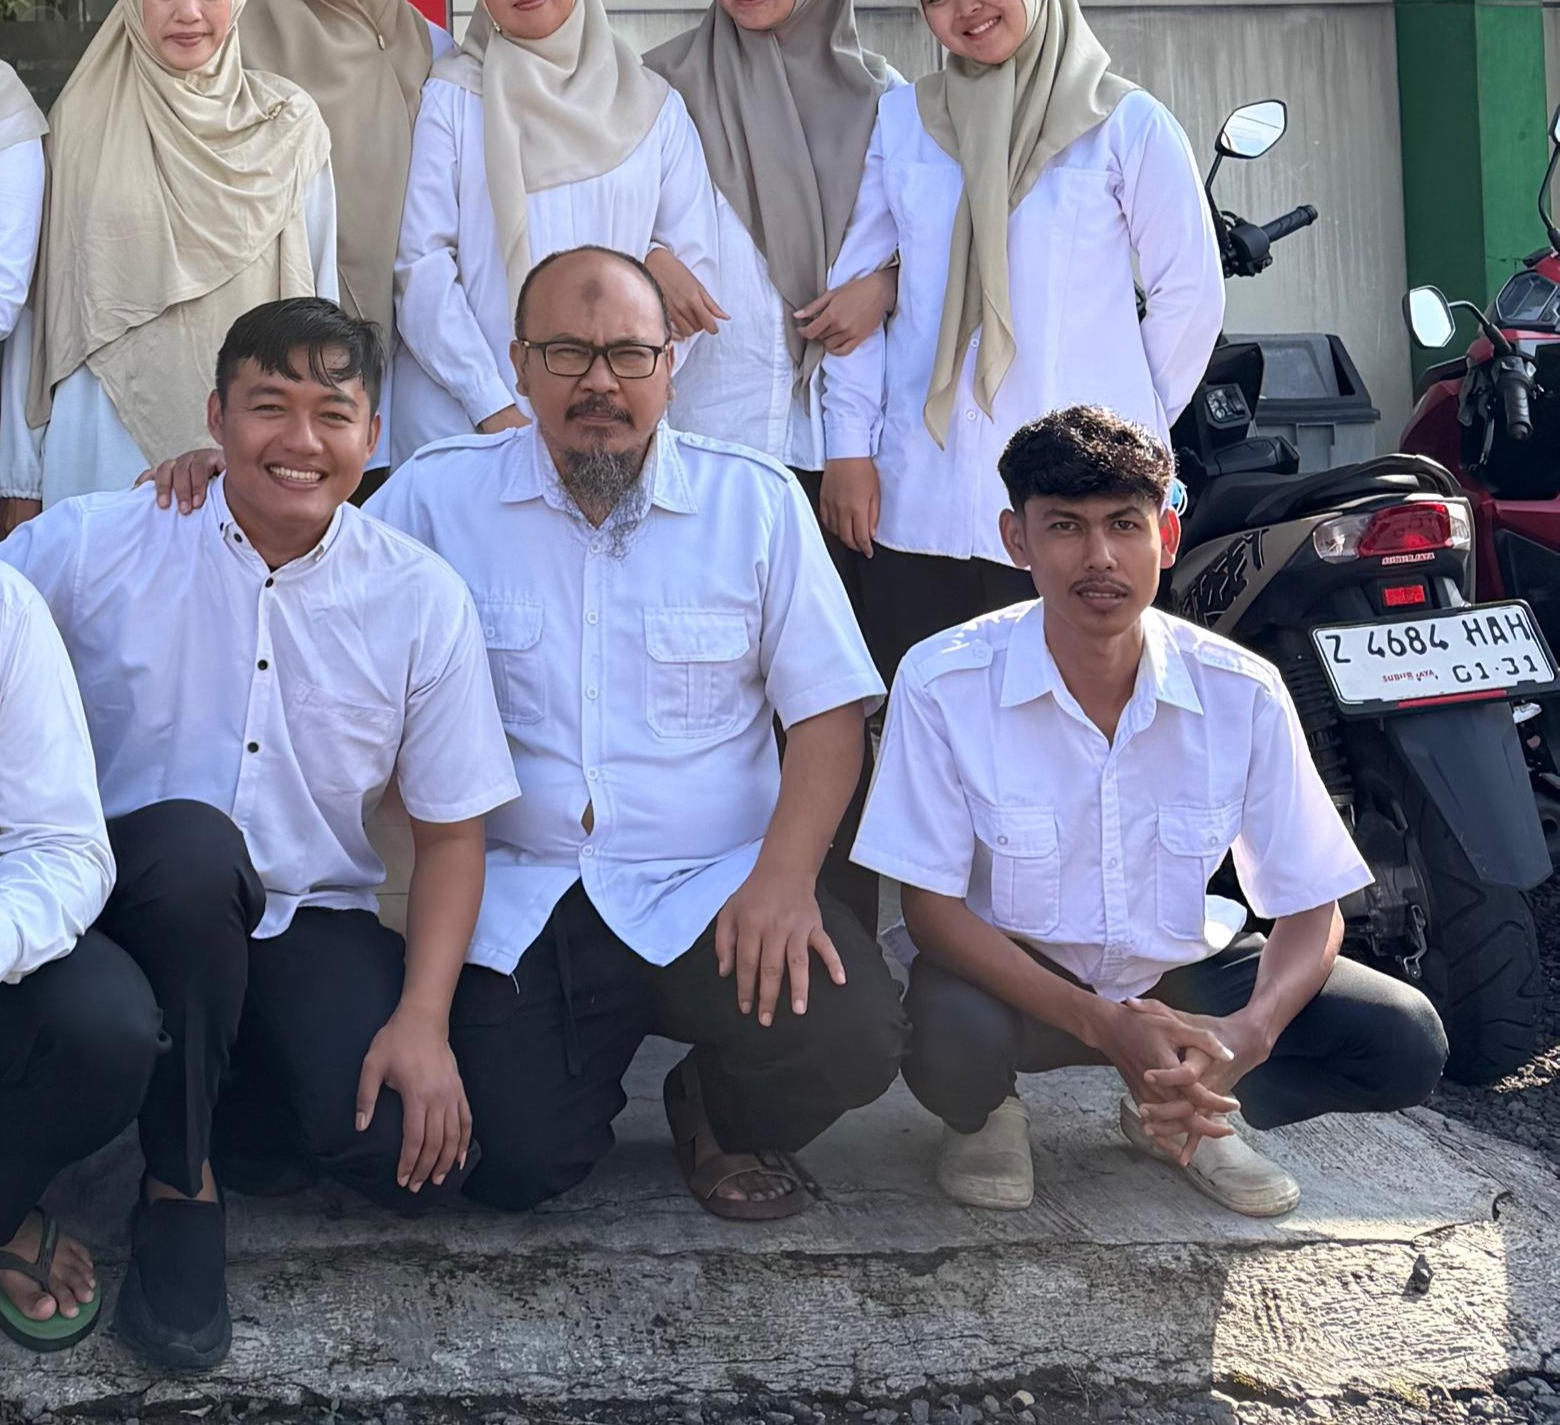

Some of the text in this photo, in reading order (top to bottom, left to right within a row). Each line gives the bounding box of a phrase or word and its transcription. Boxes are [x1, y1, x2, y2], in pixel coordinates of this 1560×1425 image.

[1325, 613, 1531, 663] Z 4684 HAH
